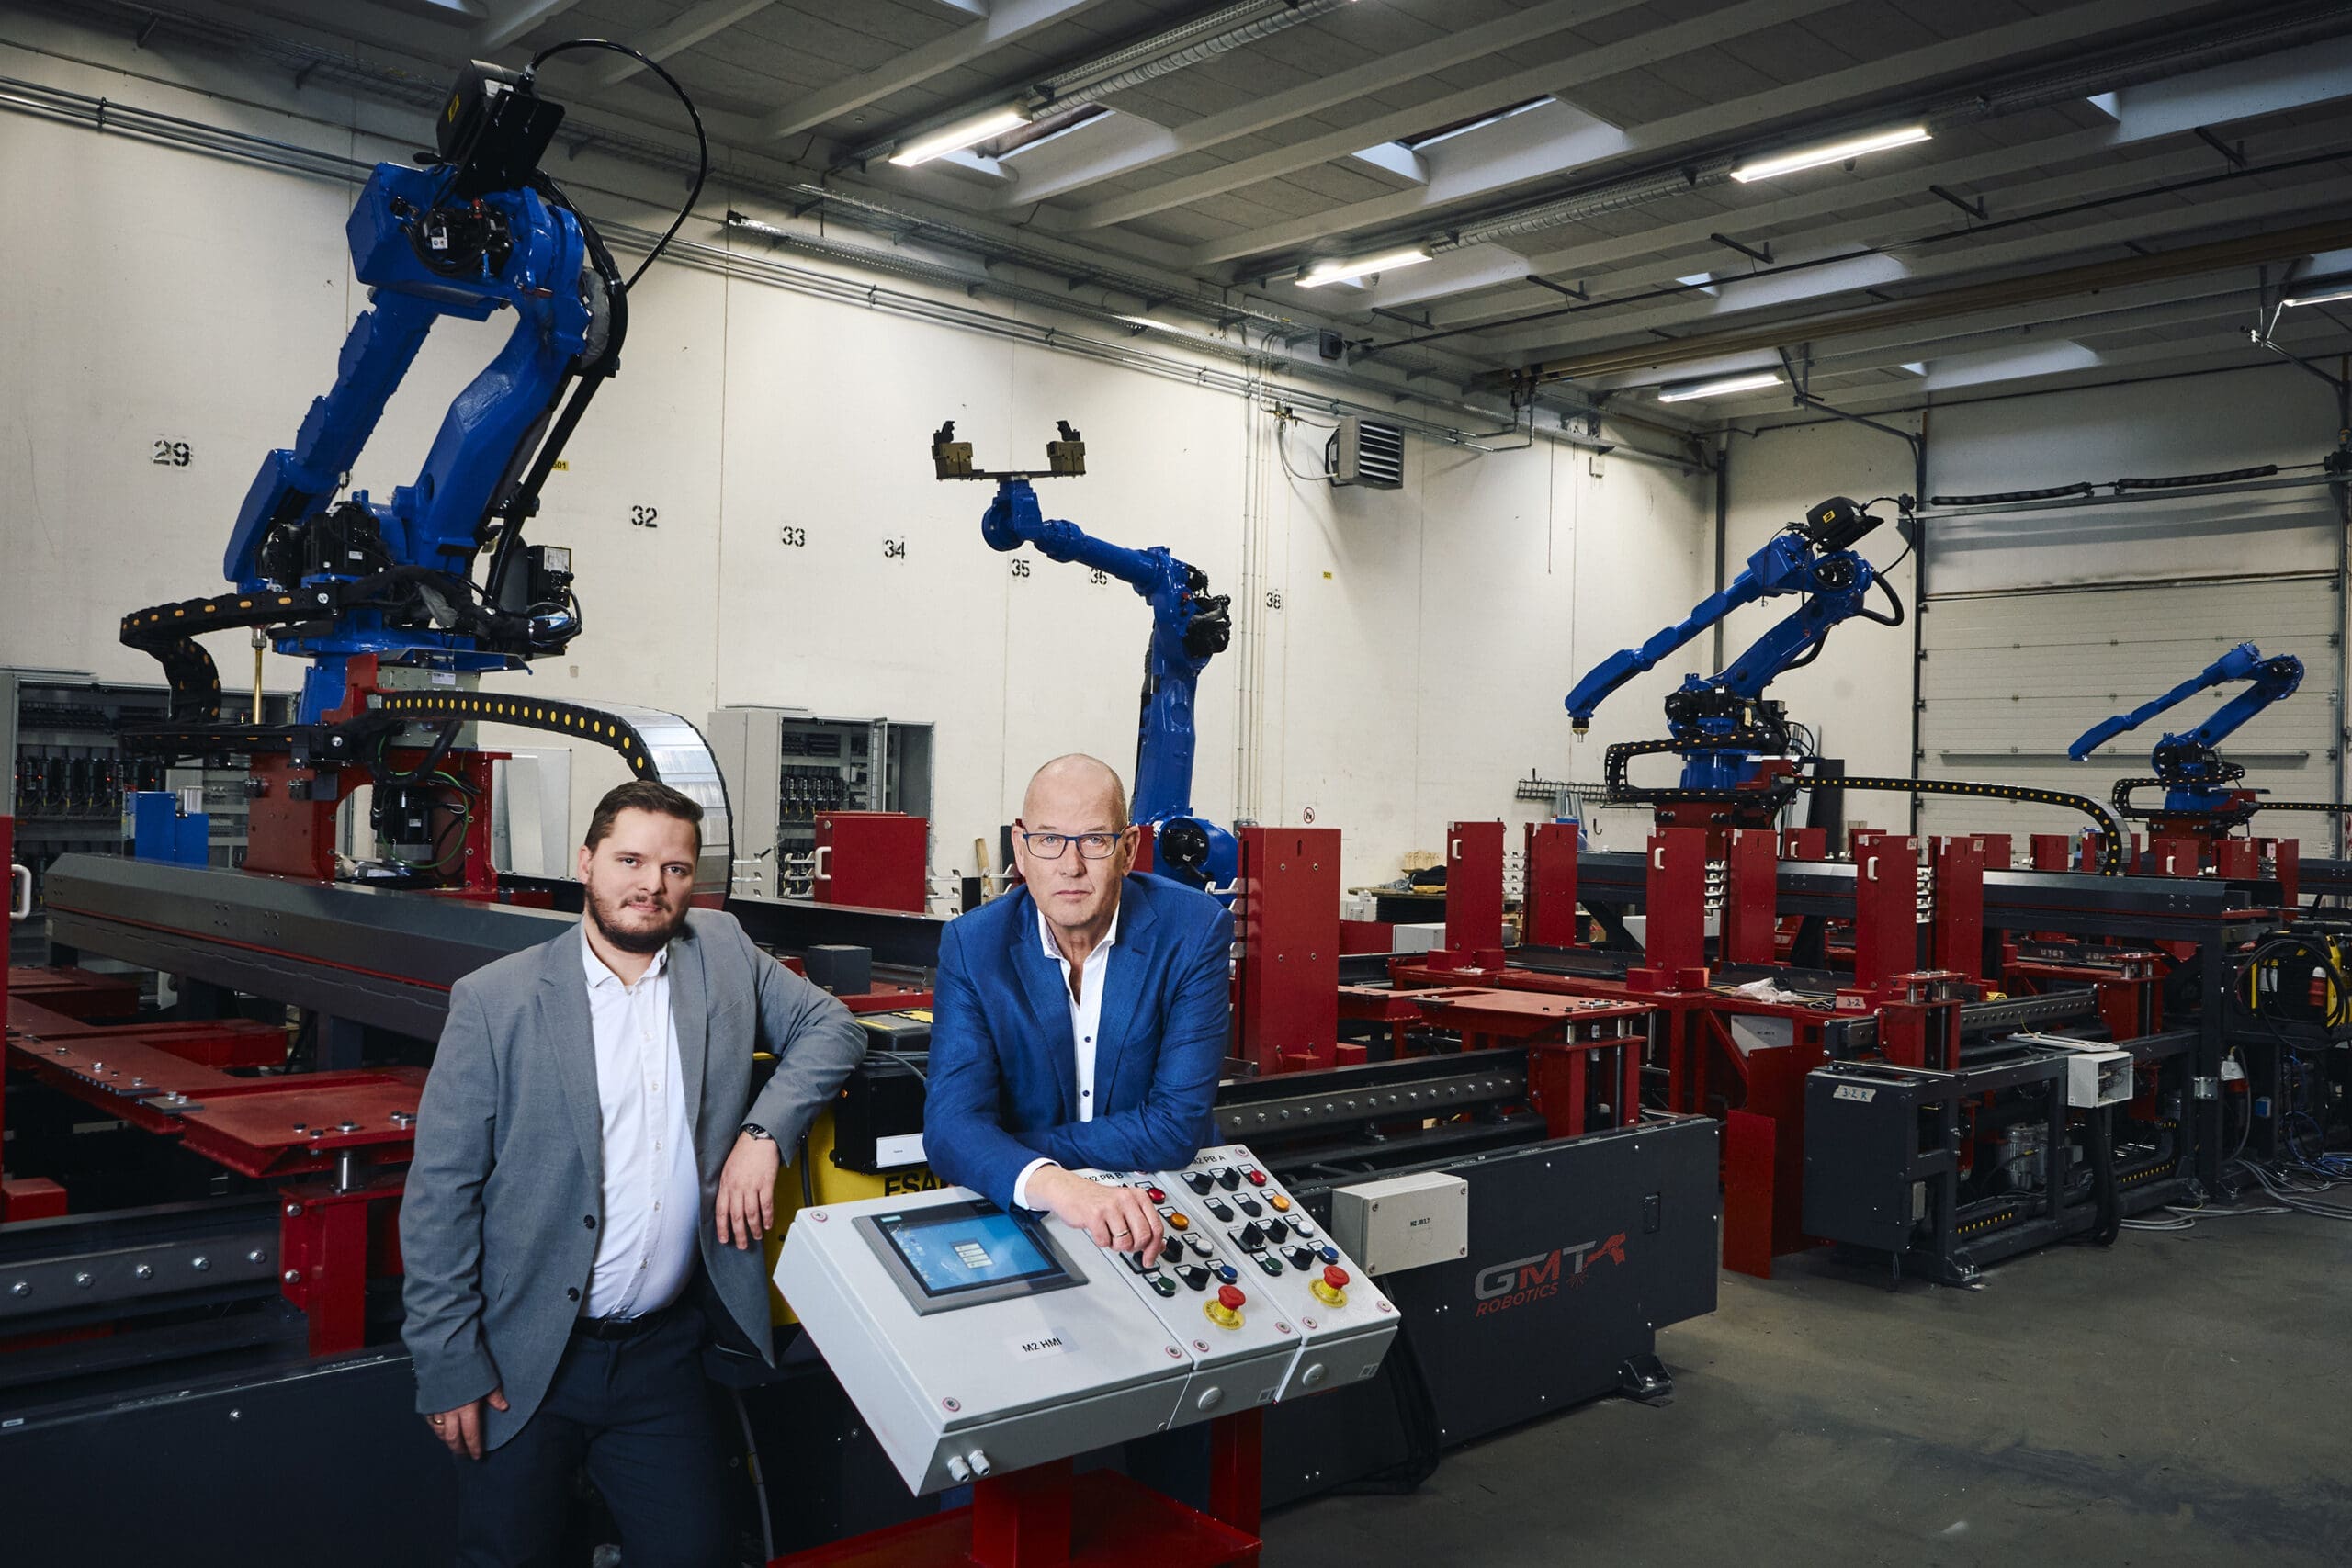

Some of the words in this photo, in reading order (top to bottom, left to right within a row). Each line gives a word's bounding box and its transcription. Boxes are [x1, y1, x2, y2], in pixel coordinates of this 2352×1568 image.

[153, 440, 189, 467] 29
[631, 505, 658, 528] 32
[782, 525, 805, 547] 33
[884, 539, 905, 559] 34
[1012, 558, 1030, 578] 35
[1091, 568, 1107, 585] 36
[1266, 592, 1281, 609] 38
[885, 1170, 946, 1197] ESA
[1475, 1240, 1597, 1301] GMT
[1476, 1282, 1559, 1317] ROBOTICS
[1022, 1342, 1040, 1353] M2
[1039, 1337, 1063, 1348] HMI
